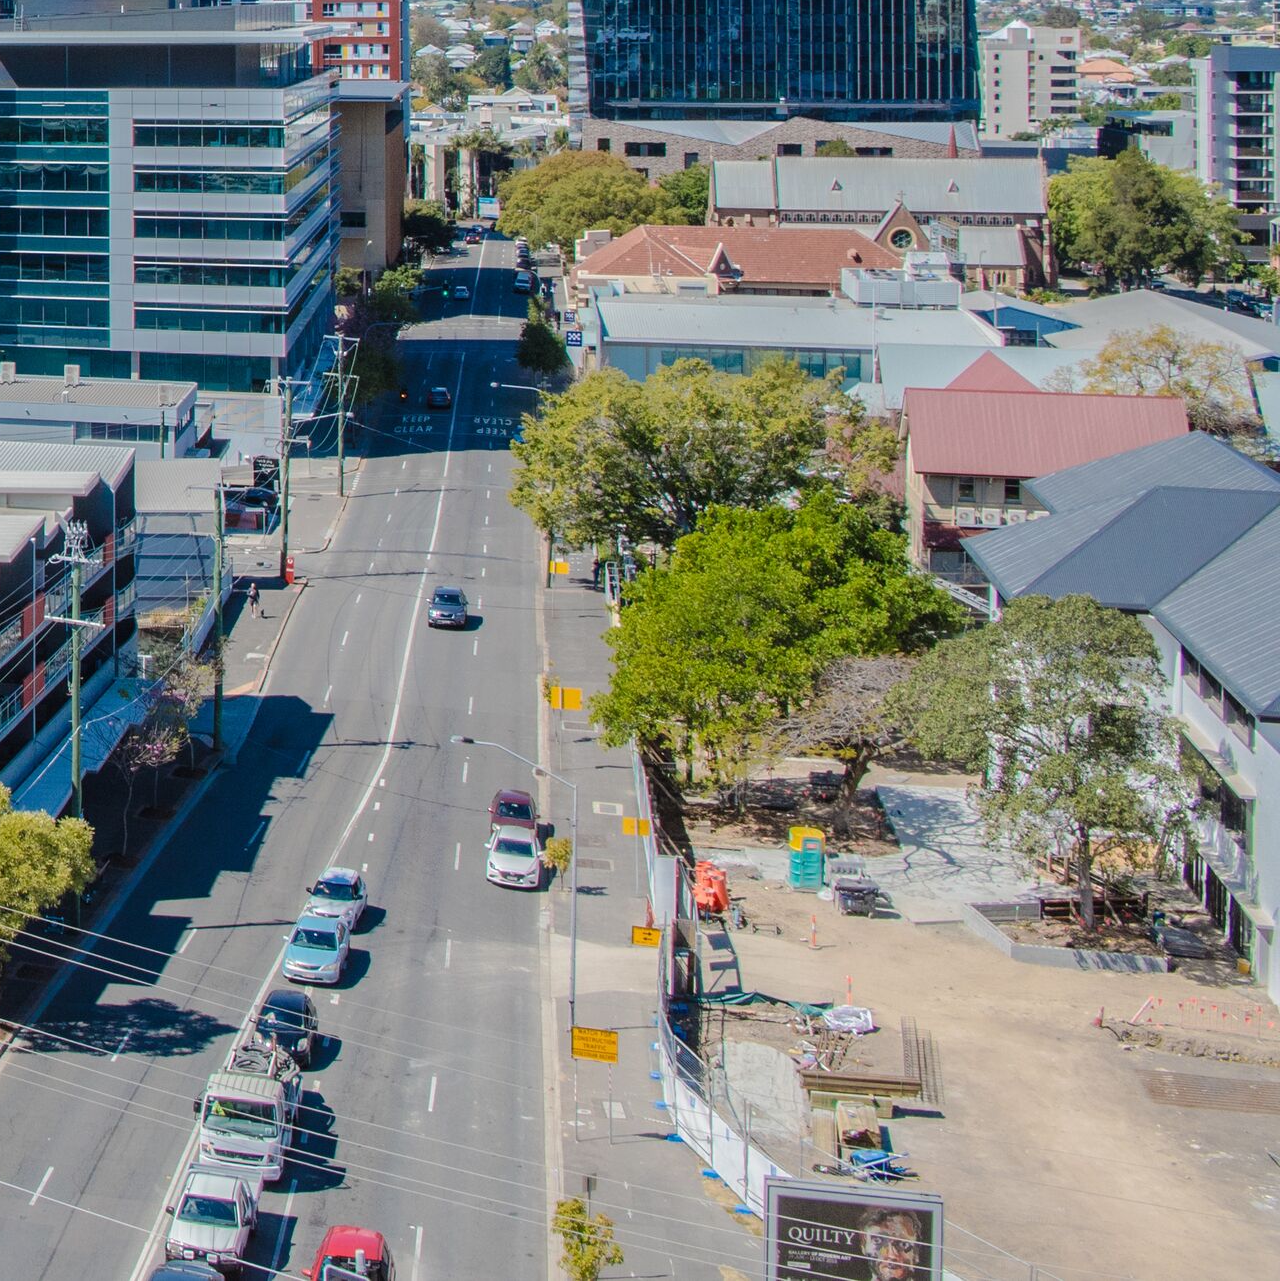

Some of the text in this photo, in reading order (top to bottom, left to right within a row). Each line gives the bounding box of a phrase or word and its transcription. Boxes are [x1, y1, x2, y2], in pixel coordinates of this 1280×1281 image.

[402, 415, 431, 423] KEEP
[473, 417, 513, 426] CLEAR
[393, 425, 433, 433] CLEAR
[476, 427, 508, 436] KEEP
[788, 1226, 856, 1245] QUILTY
